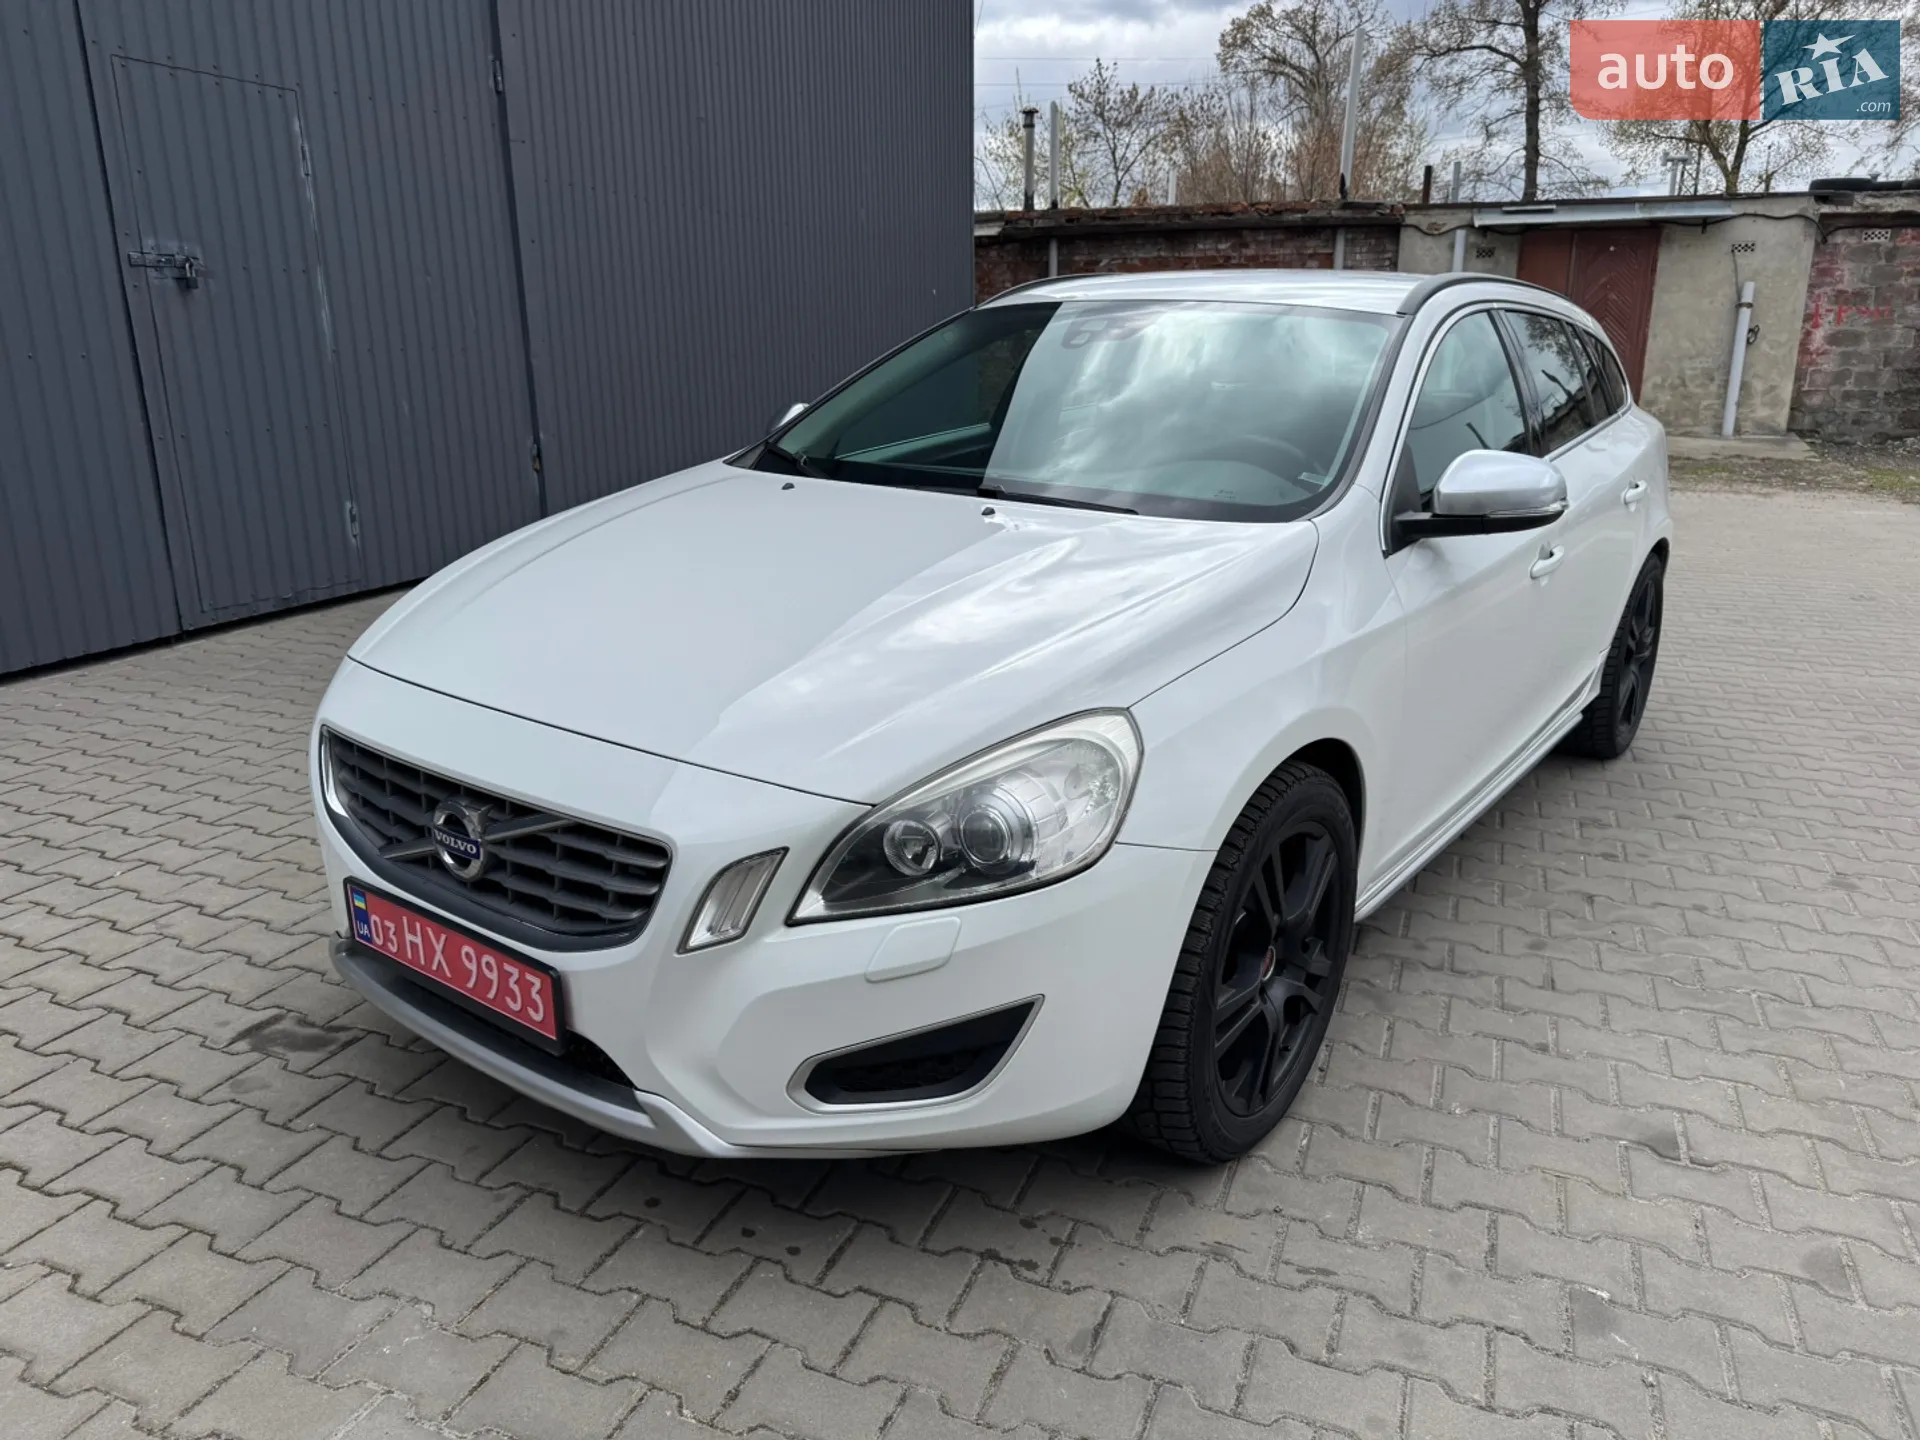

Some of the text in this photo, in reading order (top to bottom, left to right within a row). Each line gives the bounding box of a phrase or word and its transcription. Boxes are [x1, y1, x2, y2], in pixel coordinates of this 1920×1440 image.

[434, 829, 477, 854] VOLVO
[358, 921, 371, 938] UA
[371, 914, 545, 1023] 03 HX 9933
